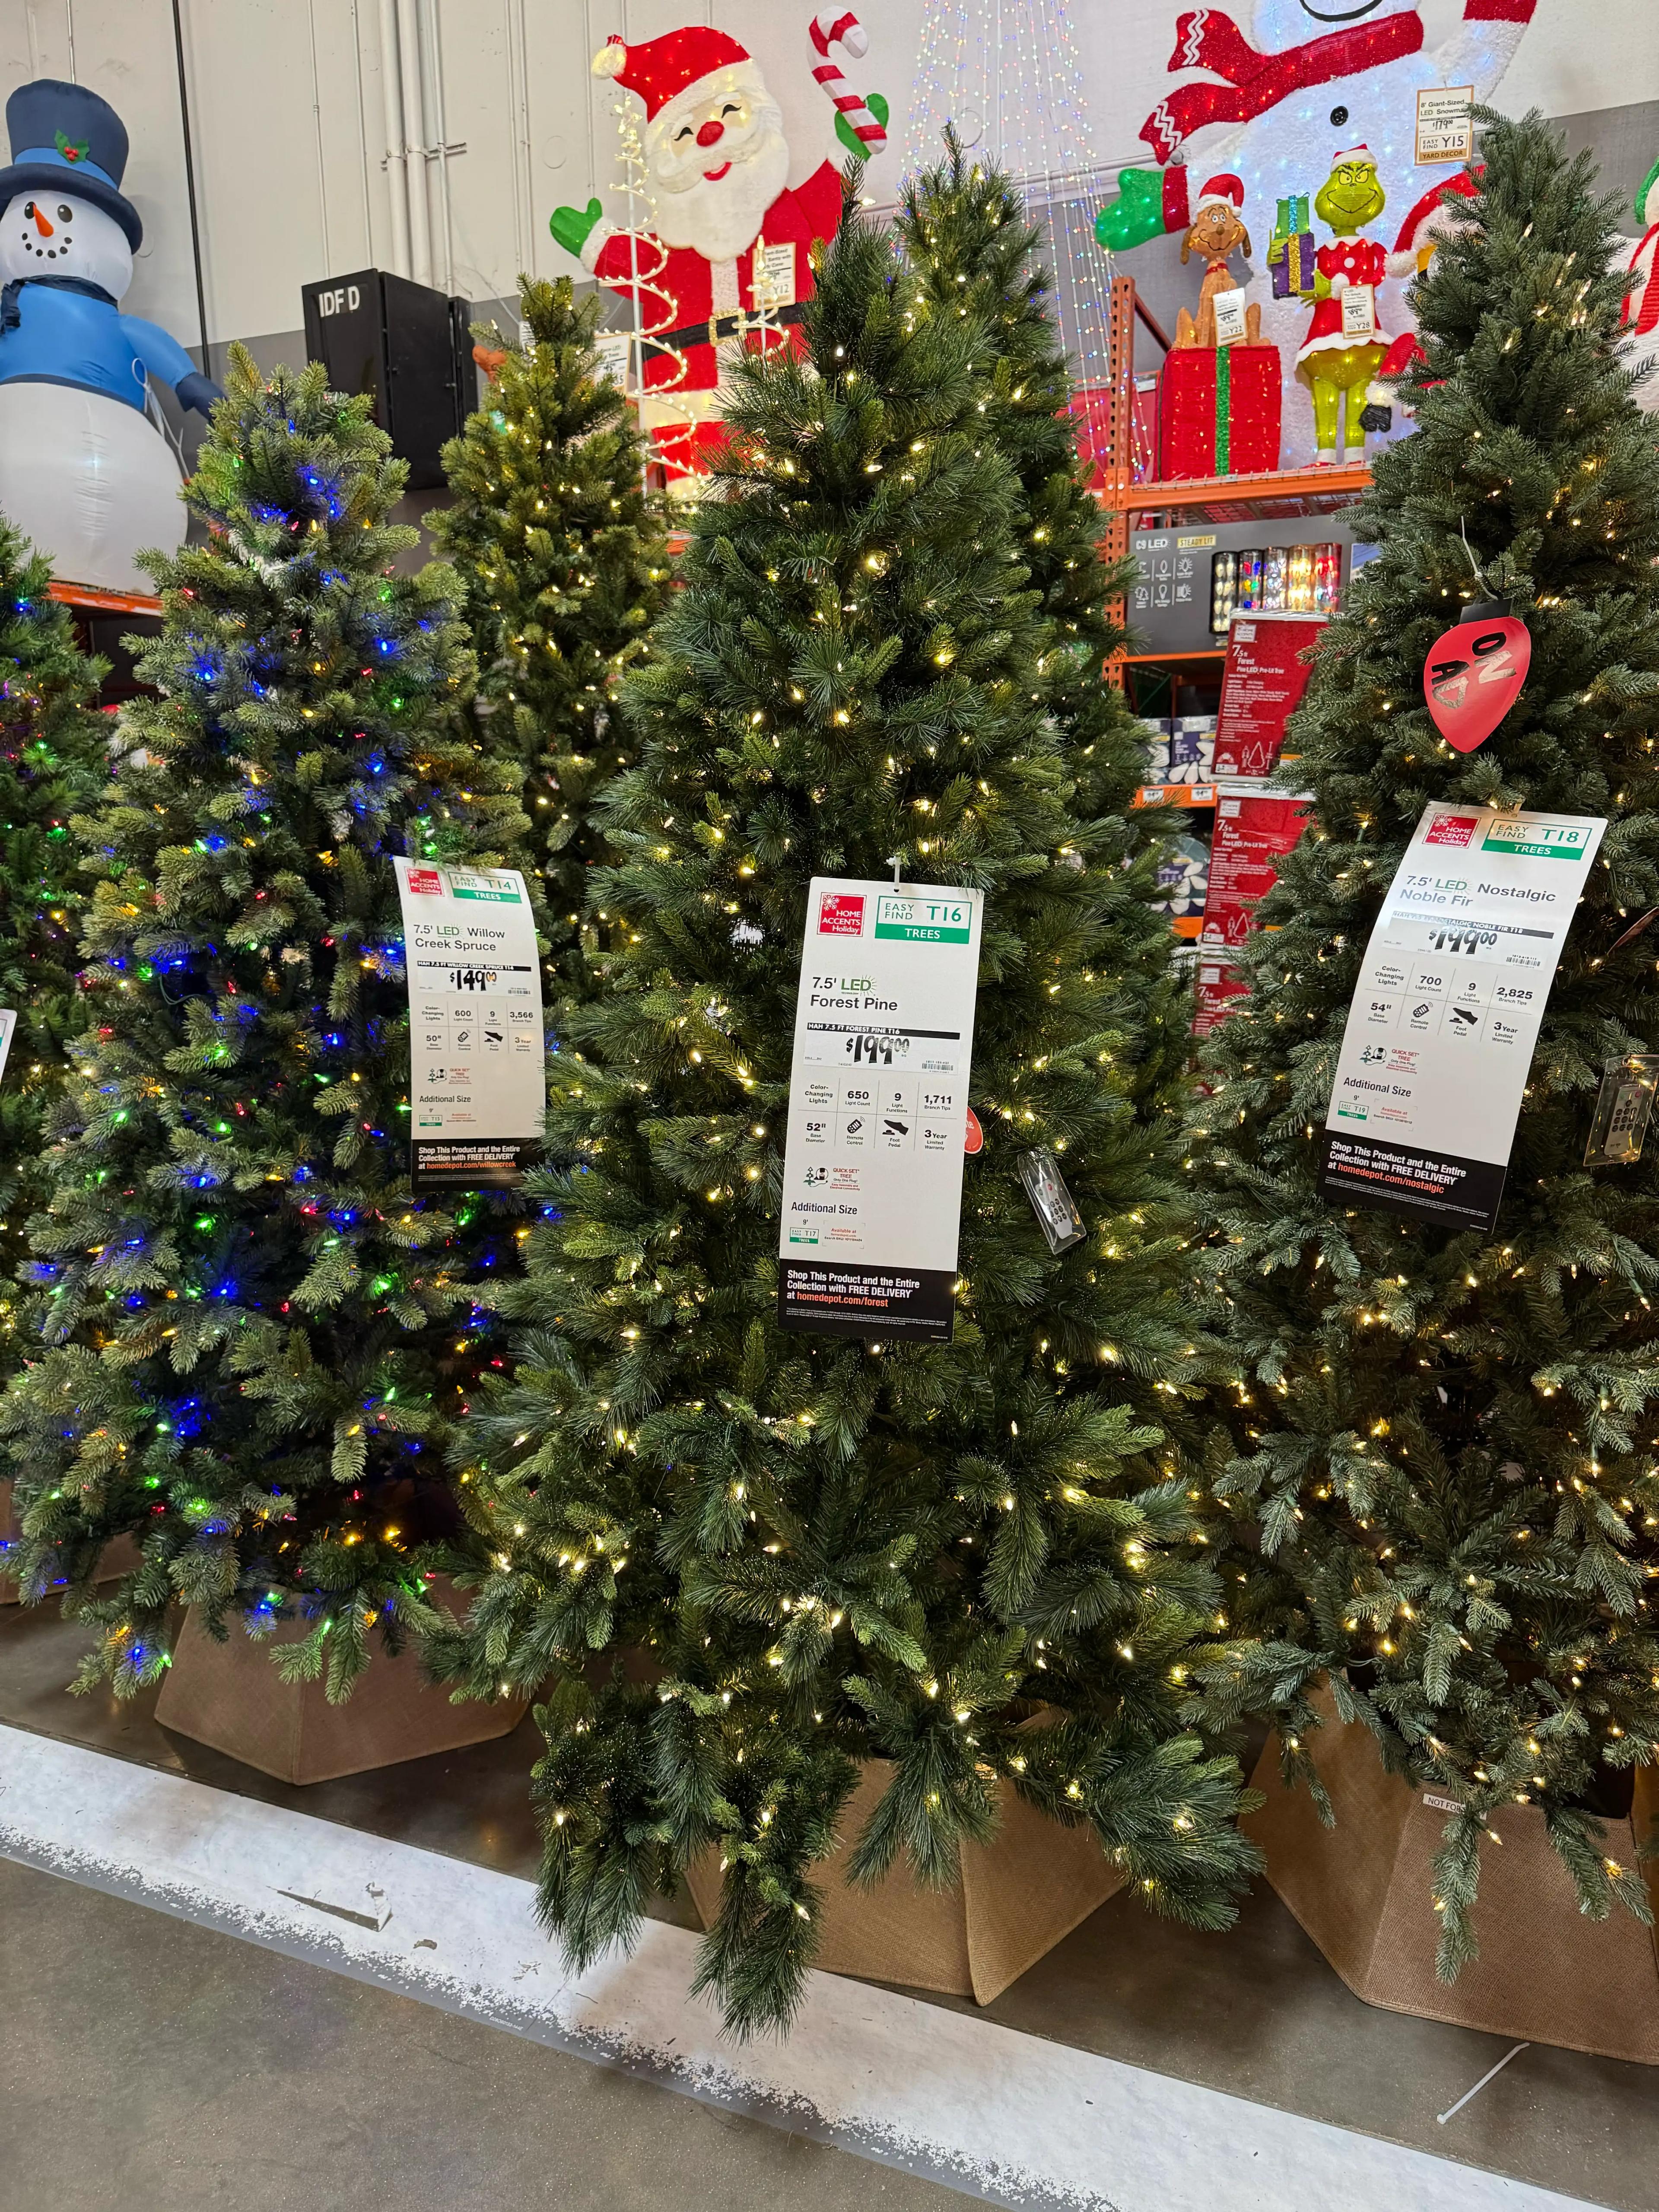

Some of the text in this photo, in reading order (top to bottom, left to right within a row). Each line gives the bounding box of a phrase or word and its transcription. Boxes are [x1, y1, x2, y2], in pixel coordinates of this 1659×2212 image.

[1442, 136, 1464, 148] Y15
[318, 285, 360, 318] IDF D
[1148, 538, 1168, 548] LED
[1497, 824, 1529, 833] EASY
[1429, 832, 1470, 840] ACCENTS
[1438, 837, 1467, 846] Holiday
[1541, 829, 1580, 843] T18
[1514, 844, 1551, 855] TREES
[484, 879, 512, 890] T14
[1407, 875, 1556, 903] 7.5' LED Nostalgic
[474, 892, 501, 900] TREES
[1400, 889, 1474, 907] Noble Fir
[885, 903, 914, 911] EASY
[885, 912, 913, 920] FIND
[927, 906, 962, 922] T16
[822, 917, 861, 926] ACCENTS
[1472, 922, 1497, 930] NOBLE
[413, 925, 505, 938] 7.5' LED Willow
[832, 925, 859, 934] Holiday
[905, 928, 941, 939] TREES
[415, 938, 496, 951] Creek Spruce
[1375, 972, 1404, 981] Changing
[1420, 975, 1442, 985] 700
[812, 977, 872, 991] 7.5' LED
[1496, 987, 1533, 999] 2,825
[810, 995, 898, 1011] Forest Pine
[1494, 1022, 1502, 1030] 3
[1343, 1077, 1411, 1097] Additional Size
[847, 1090, 869, 1100] 650
[894, 1093, 902, 1101] 9
[924, 1094, 952, 1105] 1,711
[924, 1129, 932, 1138] 3
[418, 1147, 435, 1155] Shop
[1329, 1151, 1369, 1166] Collection
[1371, 1160, 1390, 1171] with
[1391, 1164, 1414, 1176] FREE
[1331, 1141, 1467, 1177] Shop This Product and the Entire
[426, 1161, 516, 1170] homedepot.com/willowcreek
[1328, 1161, 1444, 1193] at homedepot.com/nostalgic
[791, 1201, 858, 1215] Additional Size
[787, 1270, 920, 1289] Shop This Product and the Entire
[787, 1280, 826, 1292] Collection
[828, 1284, 846, 1294] with
[849, 1285, 869, 1295] FREE
[786, 1291, 889, 1307] at homedepot.com/forest
[1428, 1797, 1445, 1807] NOT
